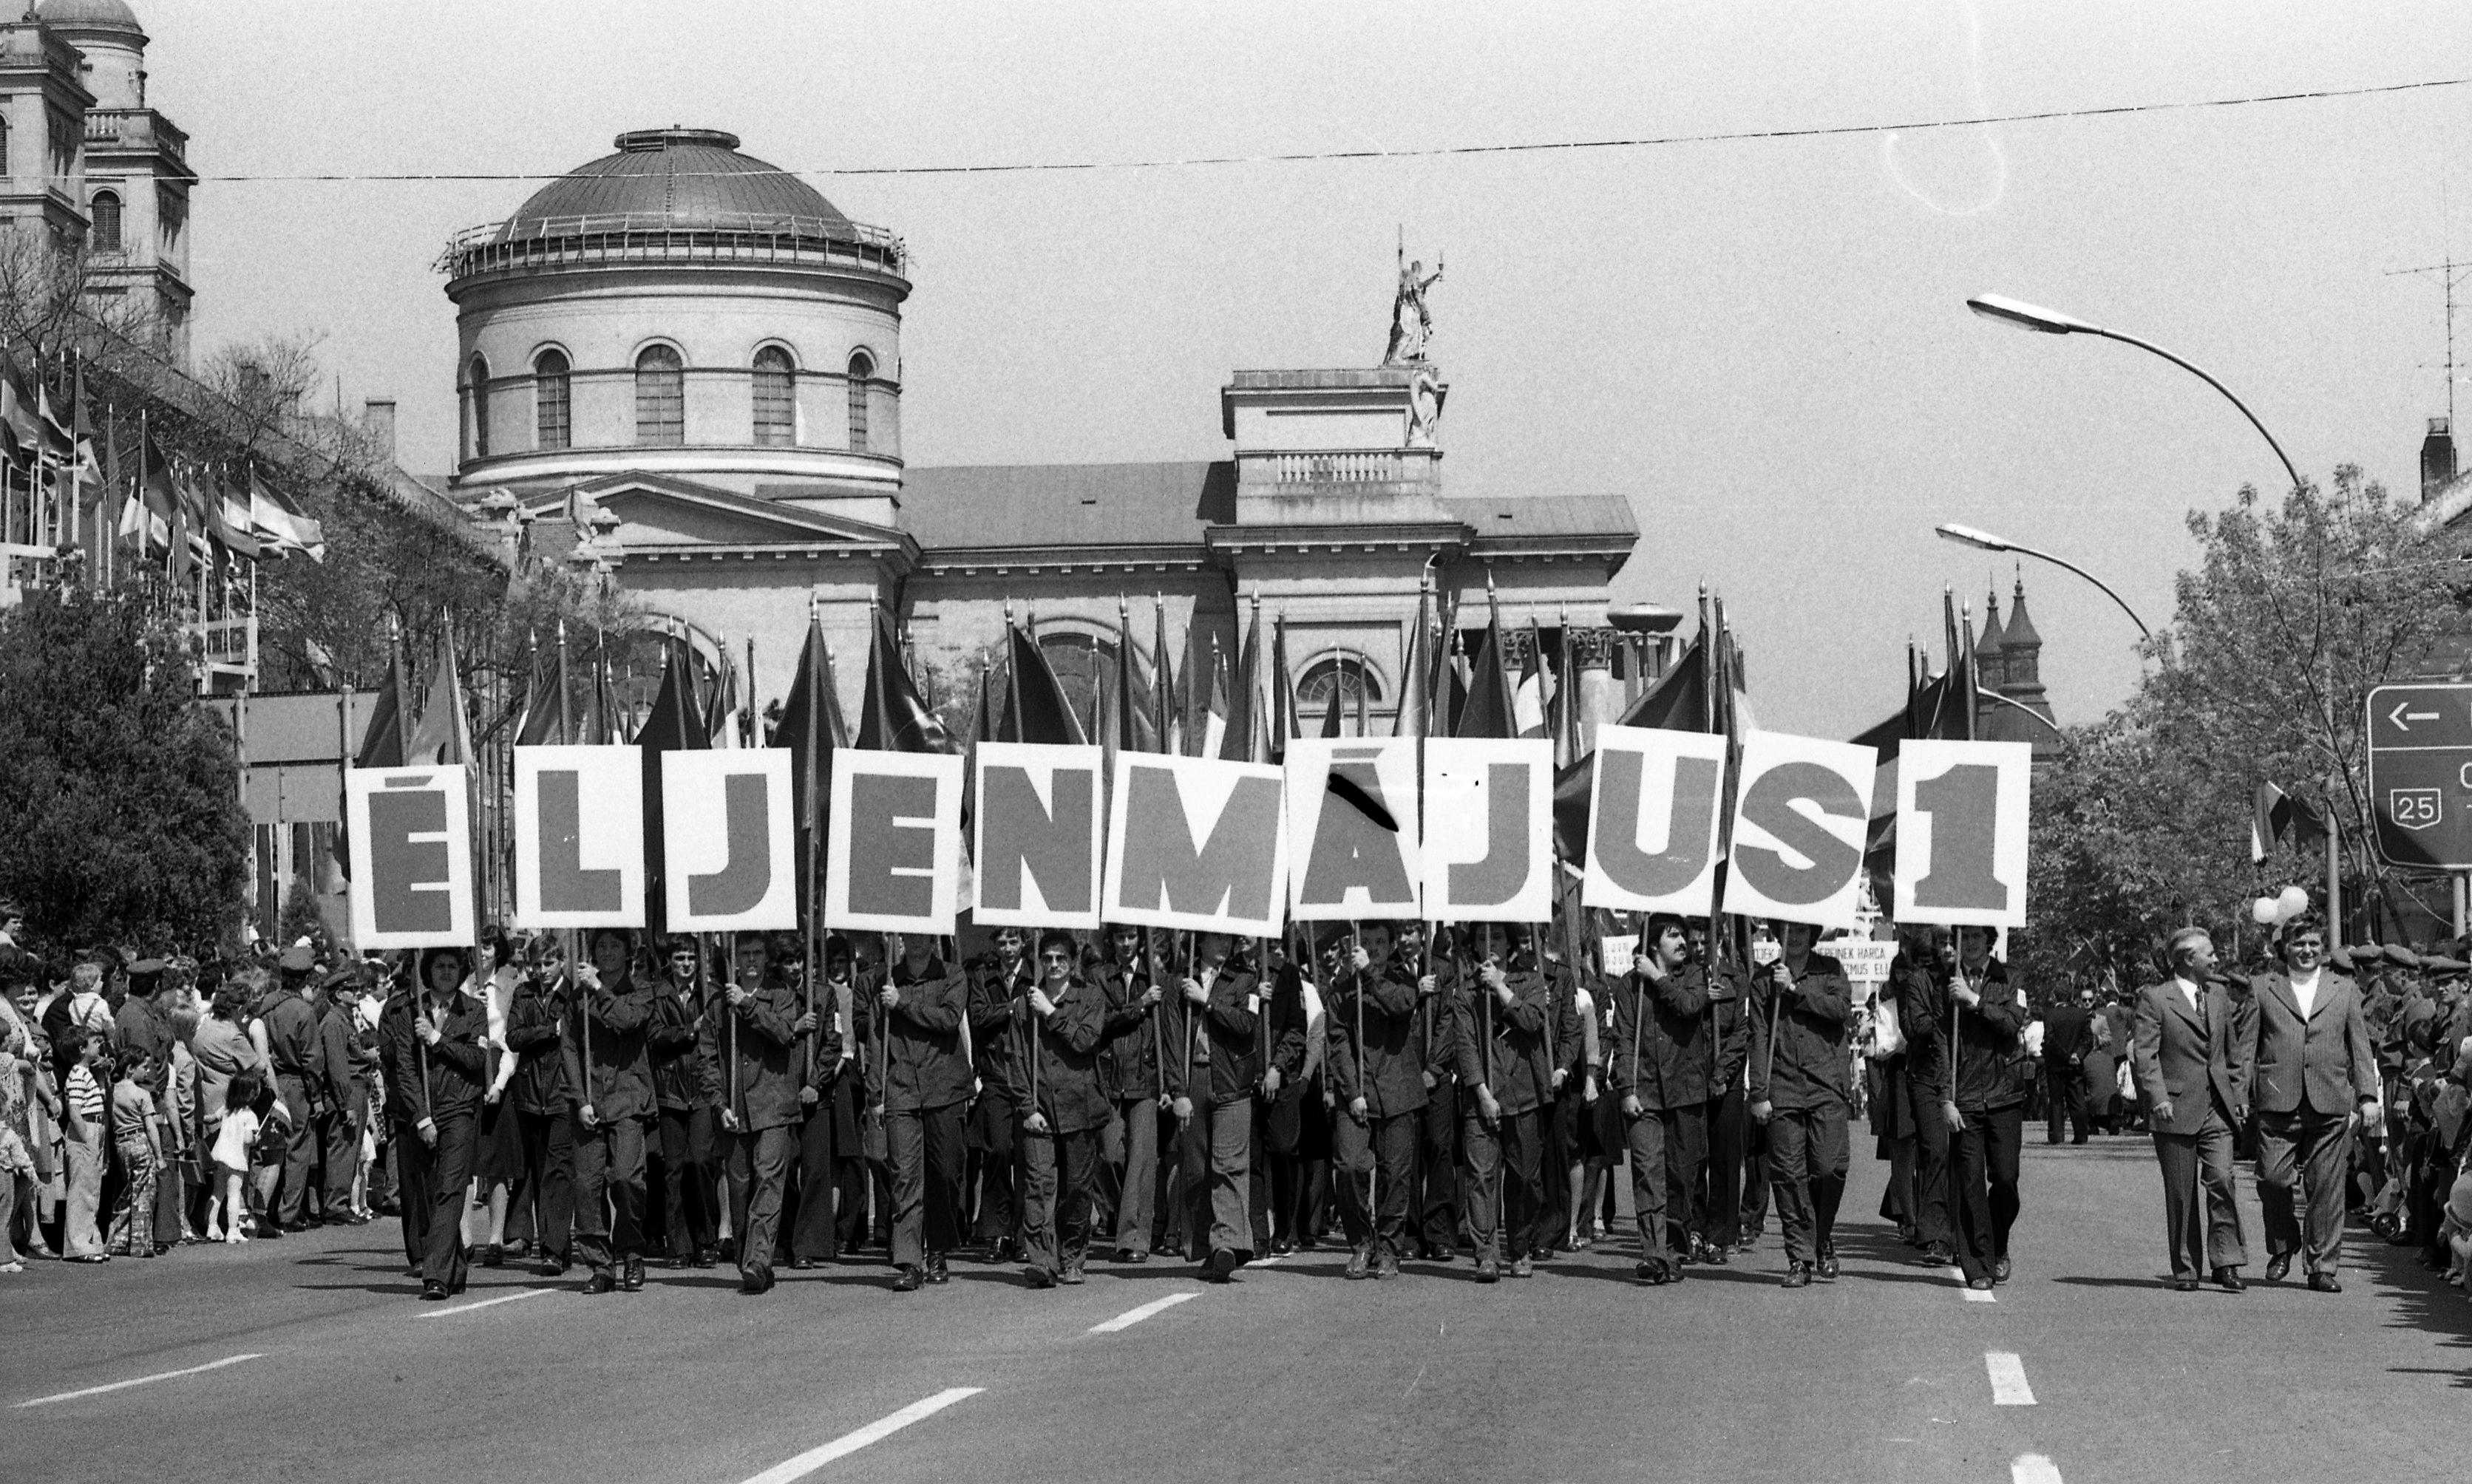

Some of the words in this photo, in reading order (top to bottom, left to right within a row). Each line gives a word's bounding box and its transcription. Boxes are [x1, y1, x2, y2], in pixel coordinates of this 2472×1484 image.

[369, 766, 1093, 933] ÉLJEN
[1118, 747, 1867, 922] MÁJUS
[1913, 763, 2008, 911] 1
[2398, 797, 2434, 820] 25
